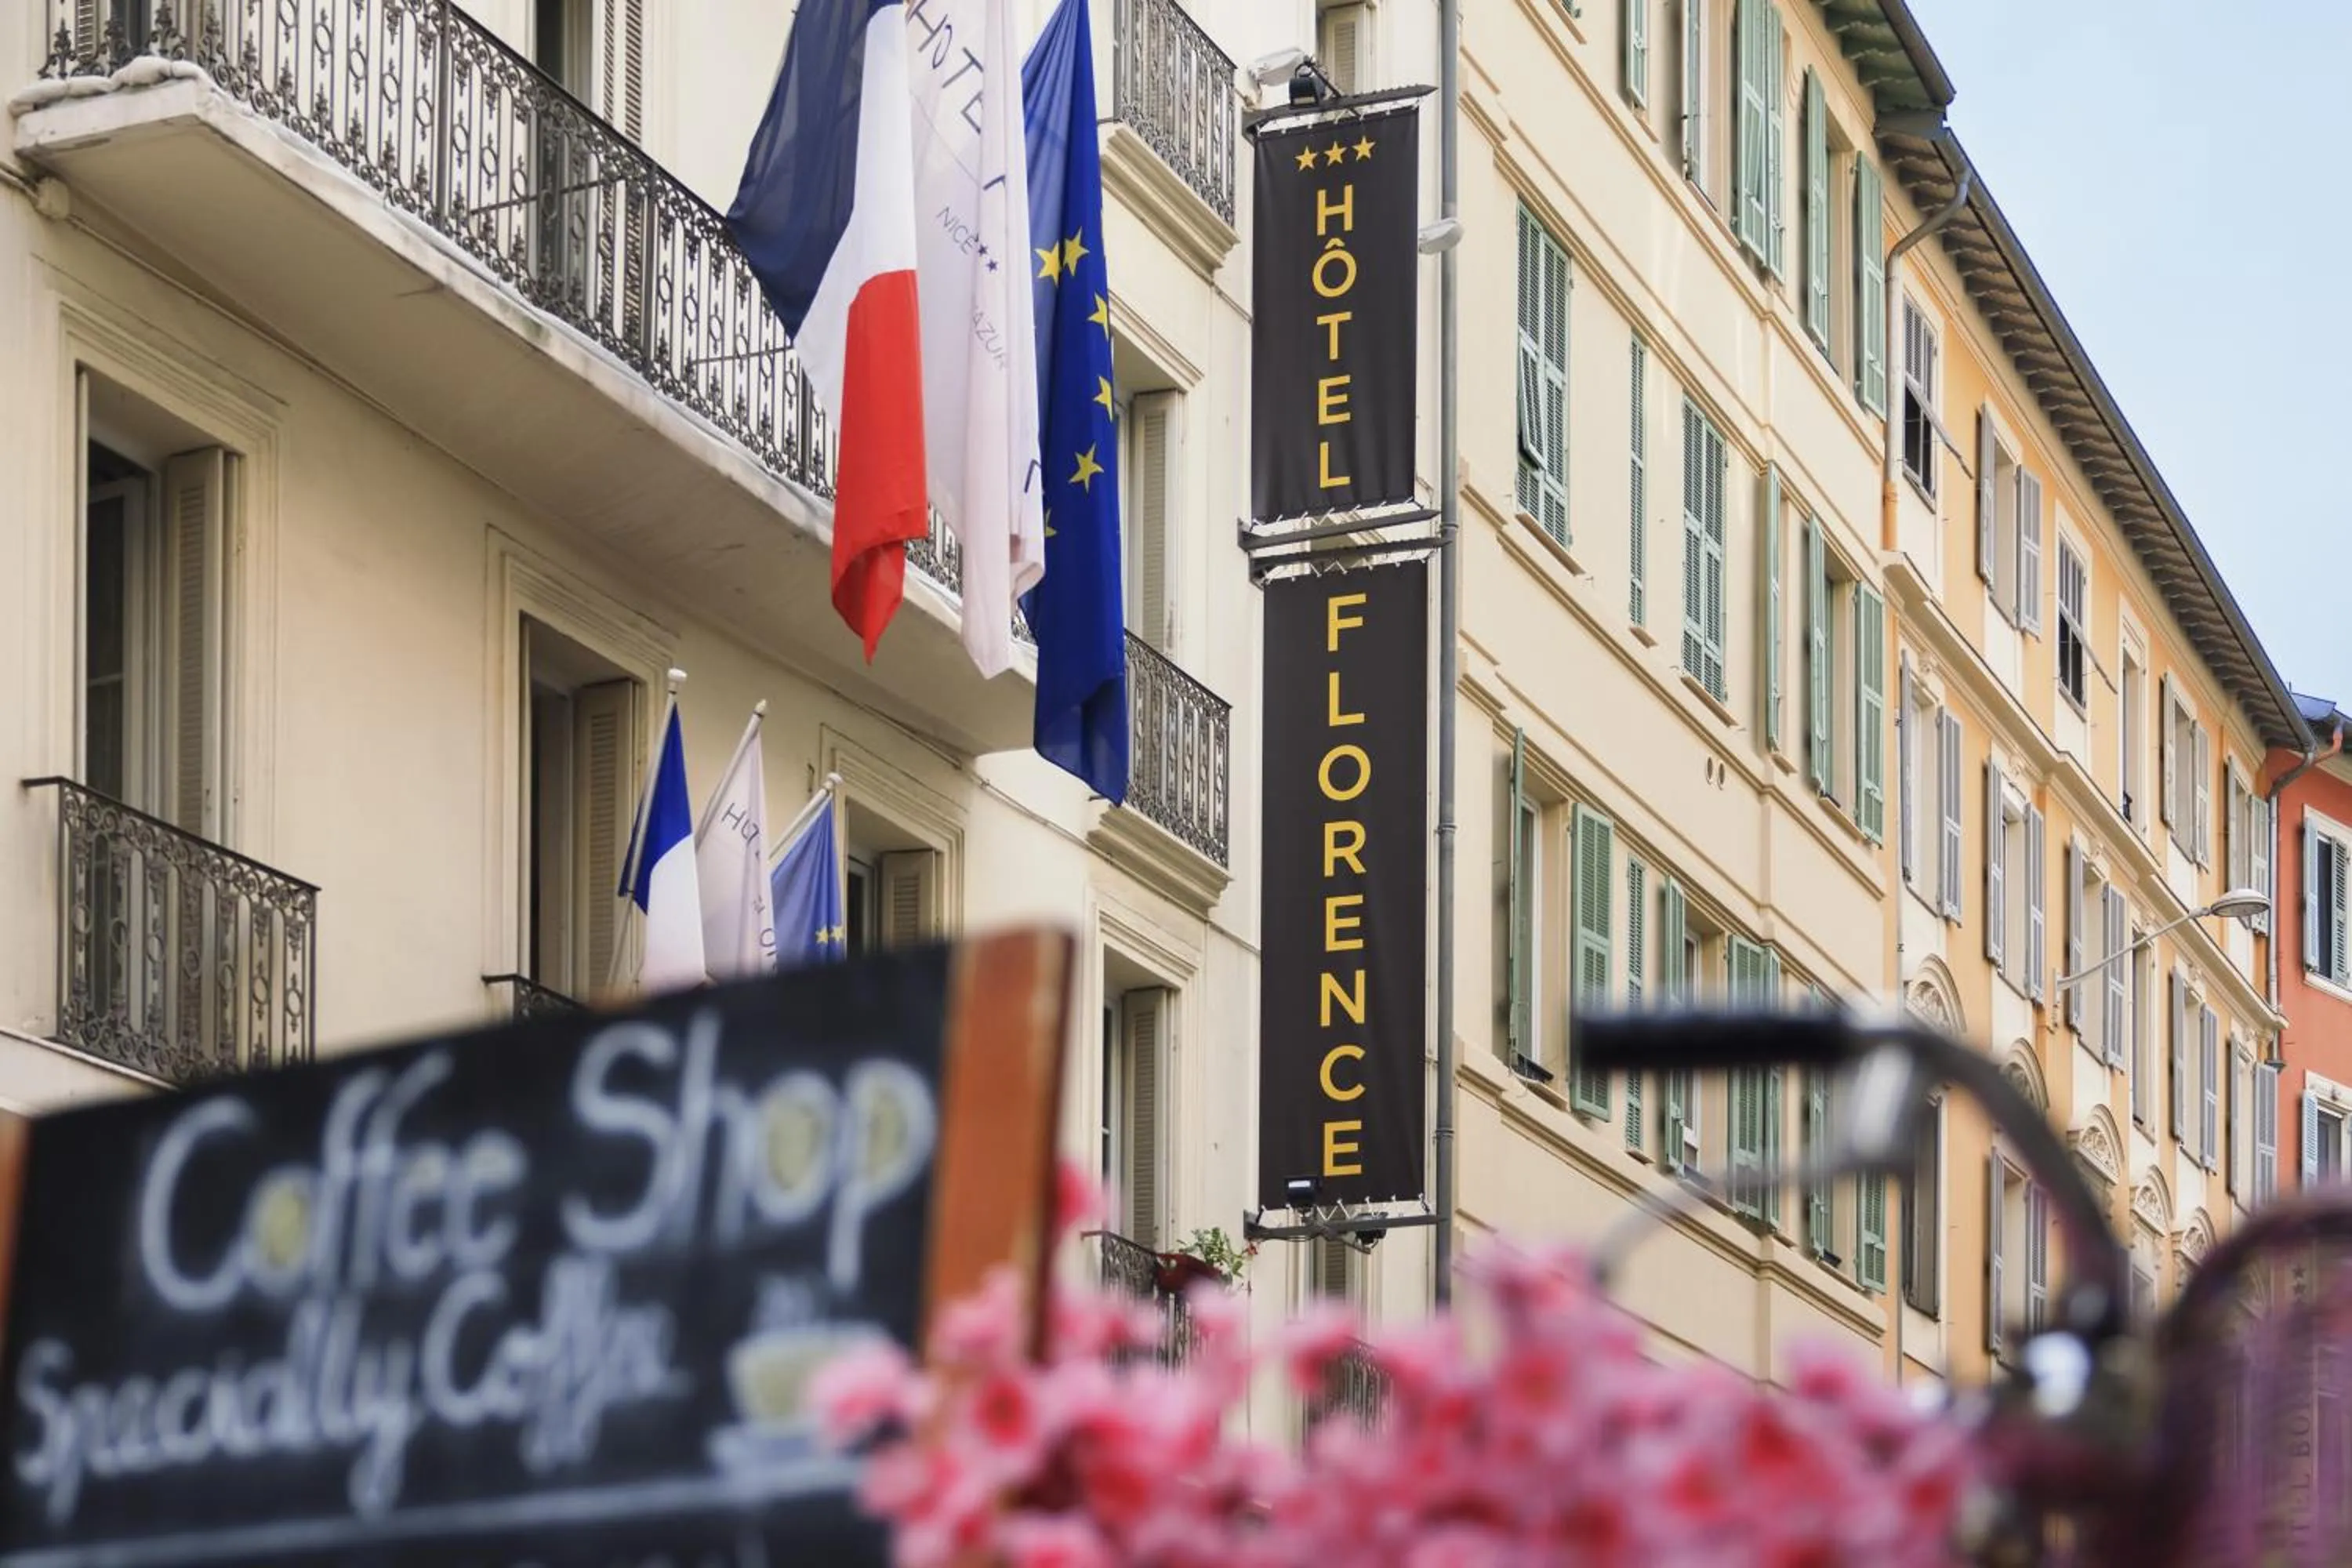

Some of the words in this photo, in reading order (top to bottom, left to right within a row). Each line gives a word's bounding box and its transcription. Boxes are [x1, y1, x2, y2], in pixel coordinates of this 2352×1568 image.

[935, 205, 977, 256] NICE
[1312, 184, 1357, 488] HÔTEL
[1318, 592, 1371, 1177] FLORENCE
[140, 1047, 535, 1312] Coffee
[560, 1007, 938, 1294] Shop
